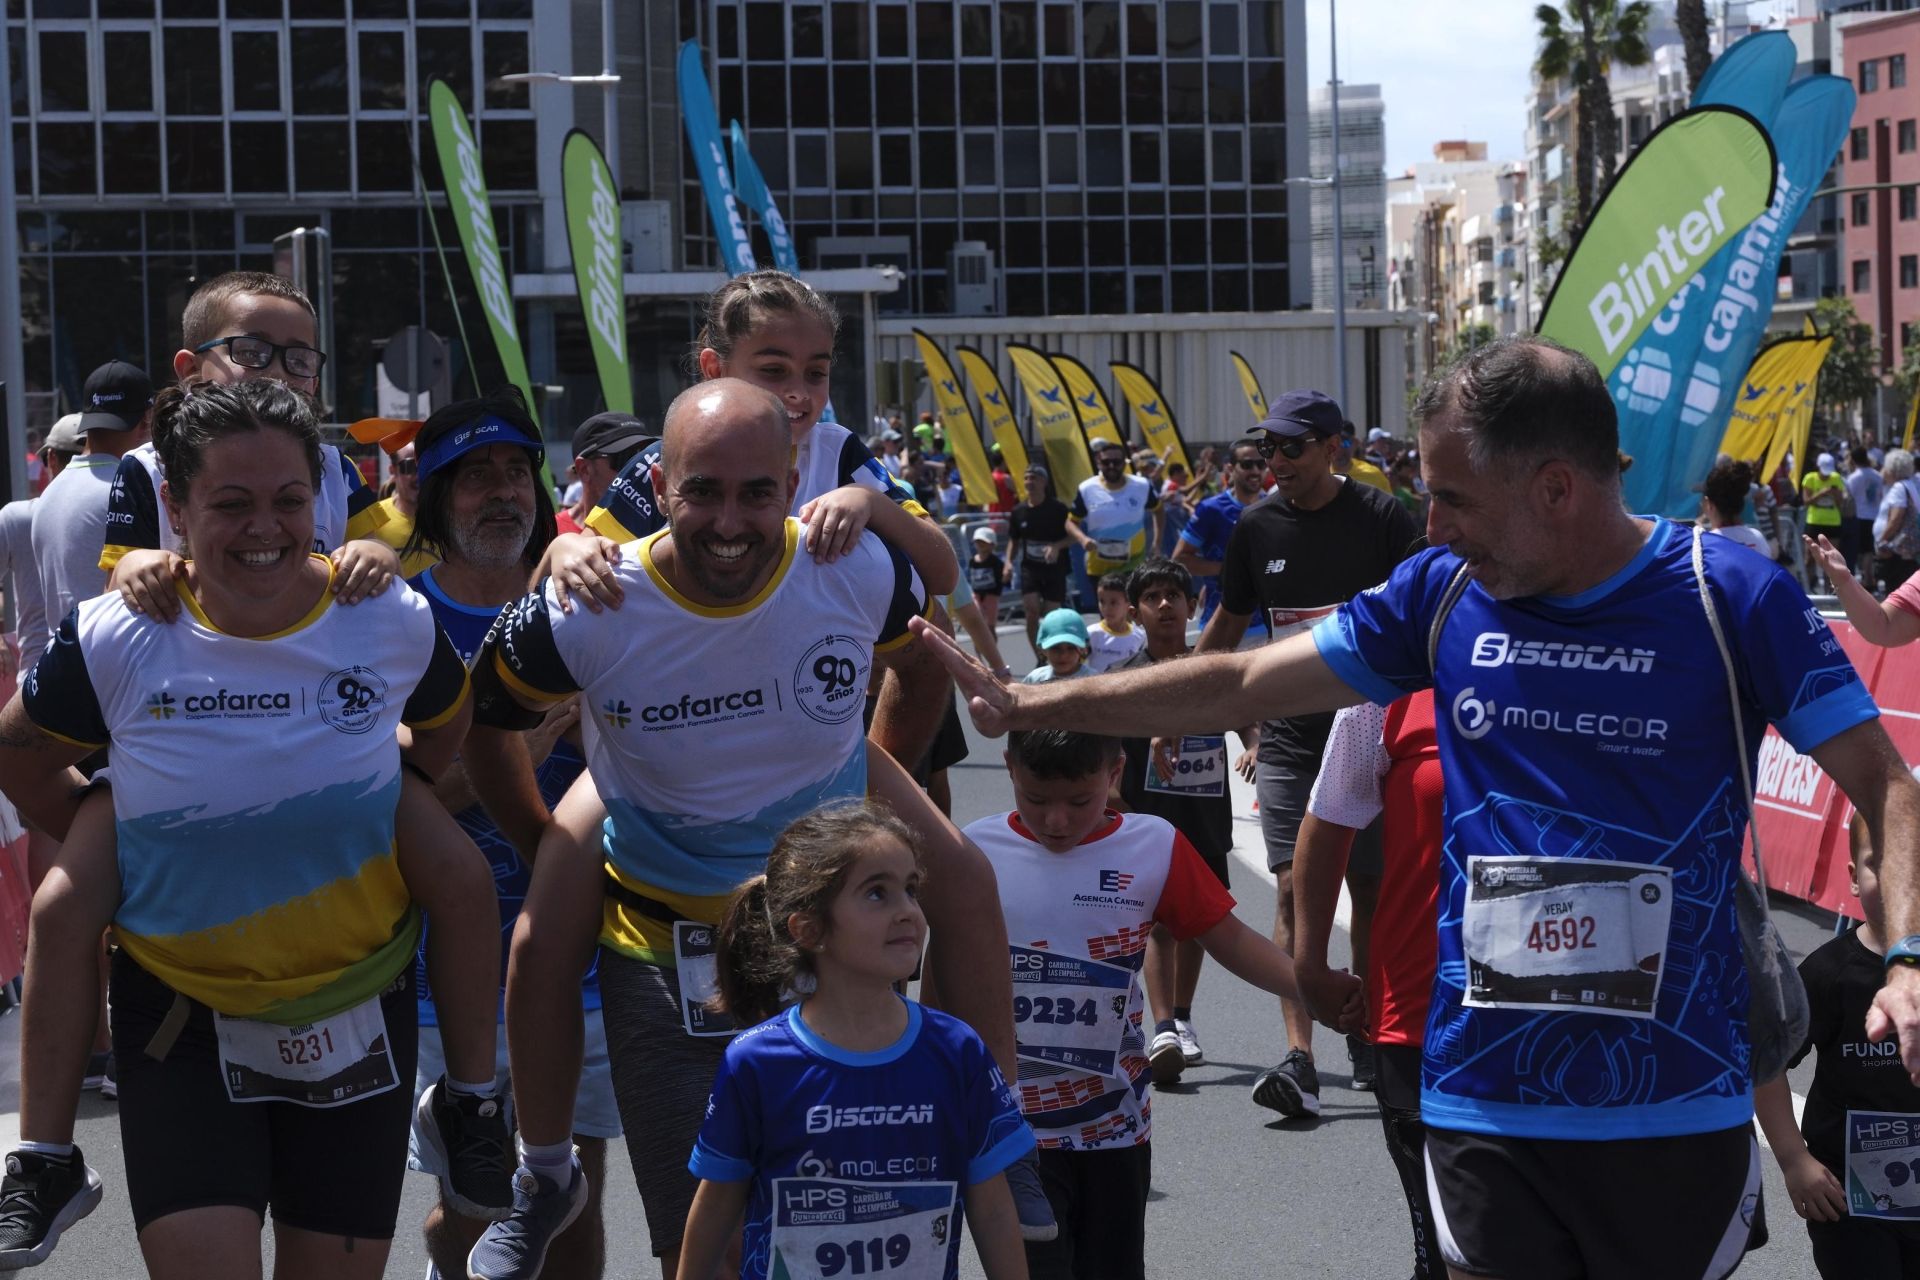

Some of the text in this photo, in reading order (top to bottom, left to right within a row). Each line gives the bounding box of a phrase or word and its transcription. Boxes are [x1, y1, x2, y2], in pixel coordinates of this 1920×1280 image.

[449, 103, 516, 341] Binter
[587, 157, 623, 363] Binter
[1704, 162, 1791, 352] cajamar
[1588, 186, 1725, 355] Binter
[611, 477, 652, 517] ofarca
[813, 655, 856, 695] 90
[184, 688, 291, 713] cofarca
[337, 678, 375, 709] 90
[797, 685, 814, 695] 1935
[826, 686, 855, 702] años
[641, 689, 763, 723] cofarca
[642, 709, 765, 732] Cooperativa Farmacéutica Canaria
[1503, 706, 1668, 741] MOLECOR
[1596, 741, 1665, 757] Smart water
[1172, 756, 1215, 774] 064
[1645, 888, 1656, 899] 5K
[1544, 902, 1575, 916] YERAY
[1527, 916, 1597, 954] 4592
[1047, 969, 1087, 978] LAS EMPRESAS
[1048, 961, 1073, 969] CARRERA
[1473, 970, 1483, 985] 11
[692, 1008, 704, 1021] 11
[1013, 996, 1098, 1026] 9234
[289, 1023, 314, 1037] NURIA
[277, 1027, 334, 1065] 5231
[229, 1071, 242, 1086] 11
[1856, 1120, 1909, 1139] HPS
[785, 1188, 847, 1209] HPS
[853, 1190, 893, 1204] CARRERA DE
[853, 1200, 899, 1214] LAS EMPRESAS
[815, 1233, 911, 1277] 9119
